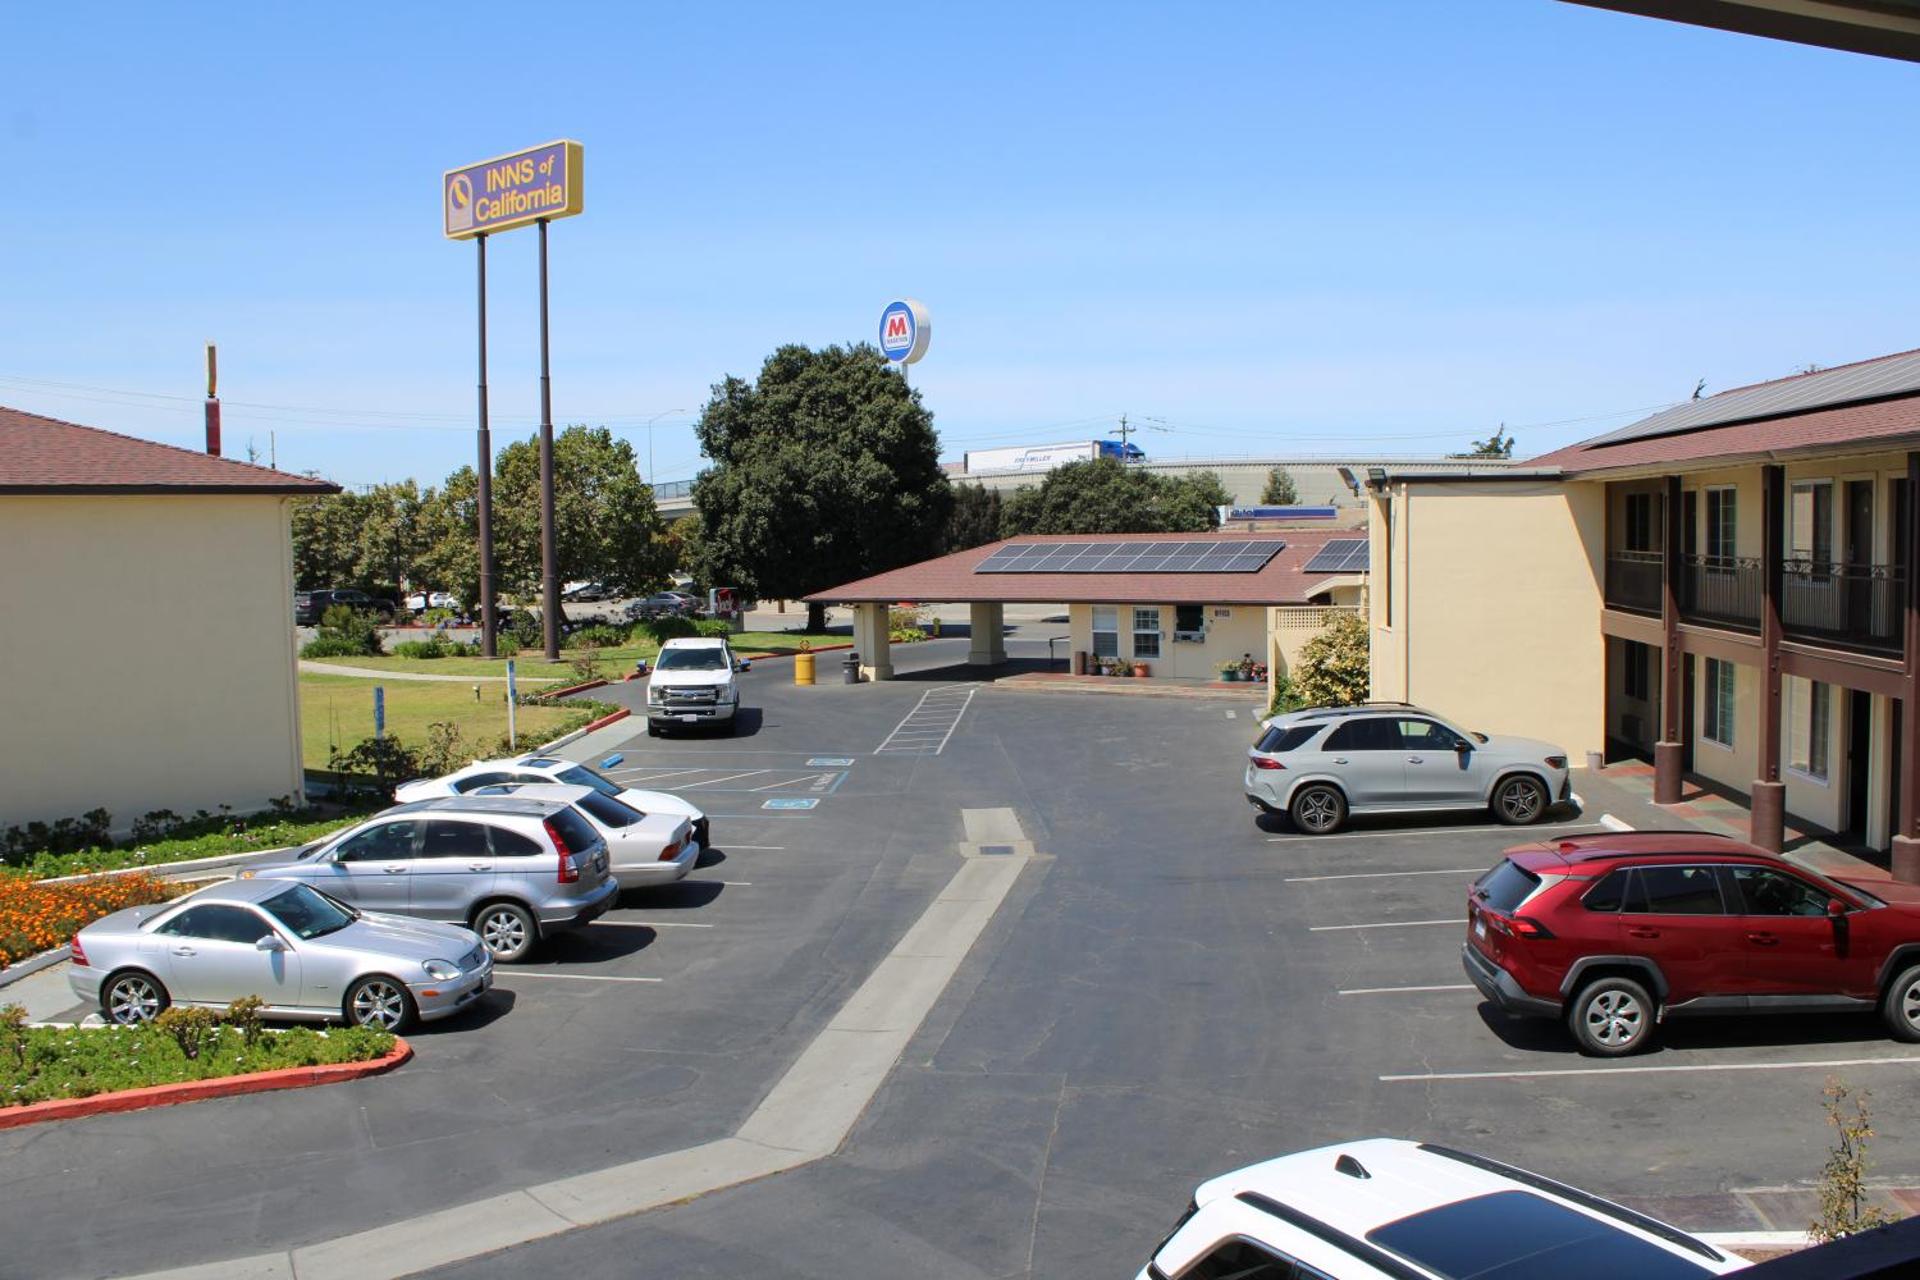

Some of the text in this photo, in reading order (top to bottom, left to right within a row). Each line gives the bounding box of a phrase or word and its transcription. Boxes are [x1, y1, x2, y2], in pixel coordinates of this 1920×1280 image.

[486, 154, 556, 193] INNS of
[475, 181, 563, 222] California
[887, 317, 907, 337] M
